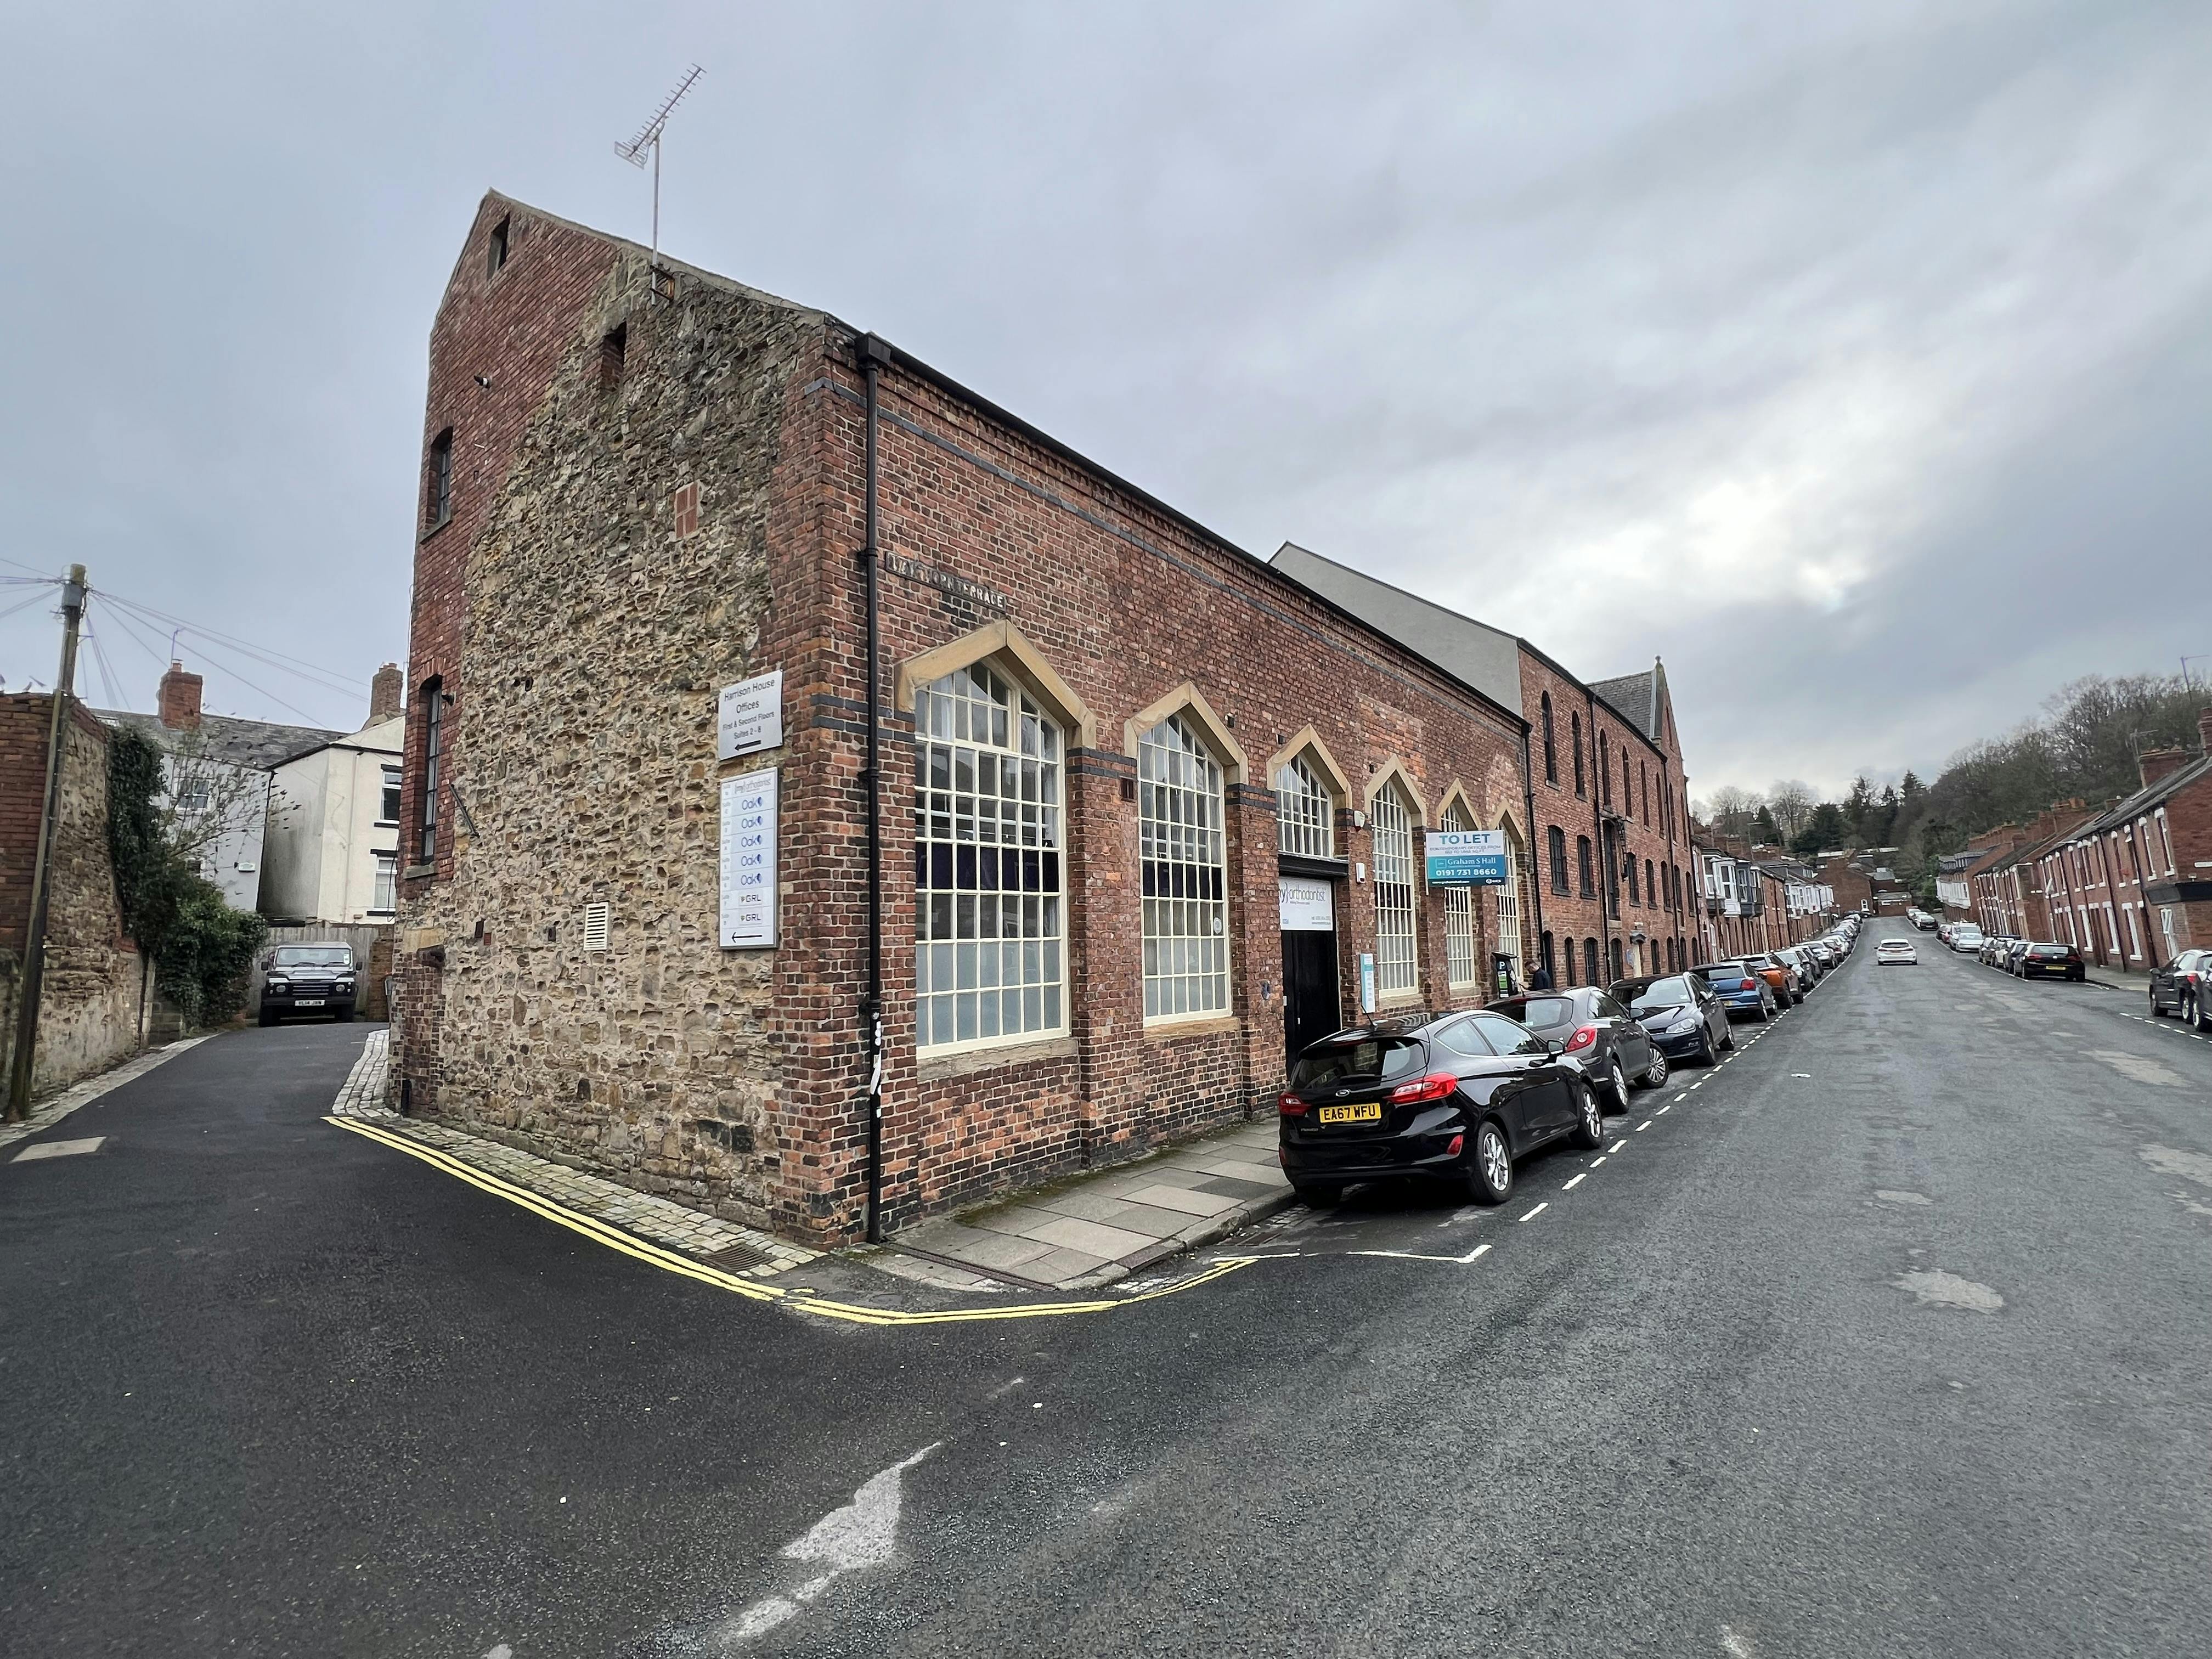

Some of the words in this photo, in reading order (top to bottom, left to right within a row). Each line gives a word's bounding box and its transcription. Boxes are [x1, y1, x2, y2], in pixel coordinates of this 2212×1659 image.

[956, 580, 1003, 608] TERRACE
[724, 686, 751, 702] Harrison
[753, 679, 775, 692] House
[736, 701, 759, 713] Offices
[723, 723, 732, 731] First
[738, 715, 757, 726] Second
[758, 712, 775, 720] Floors
[734, 730, 748, 739] Suites
[1438, 834, 1460, 845] TO
[1464, 834, 1491, 844] LET
[1499, 961, 1505, 970] P
[1323, 1108, 1351, 1120] EA67
[1353, 1105, 1376, 1118] WFU
